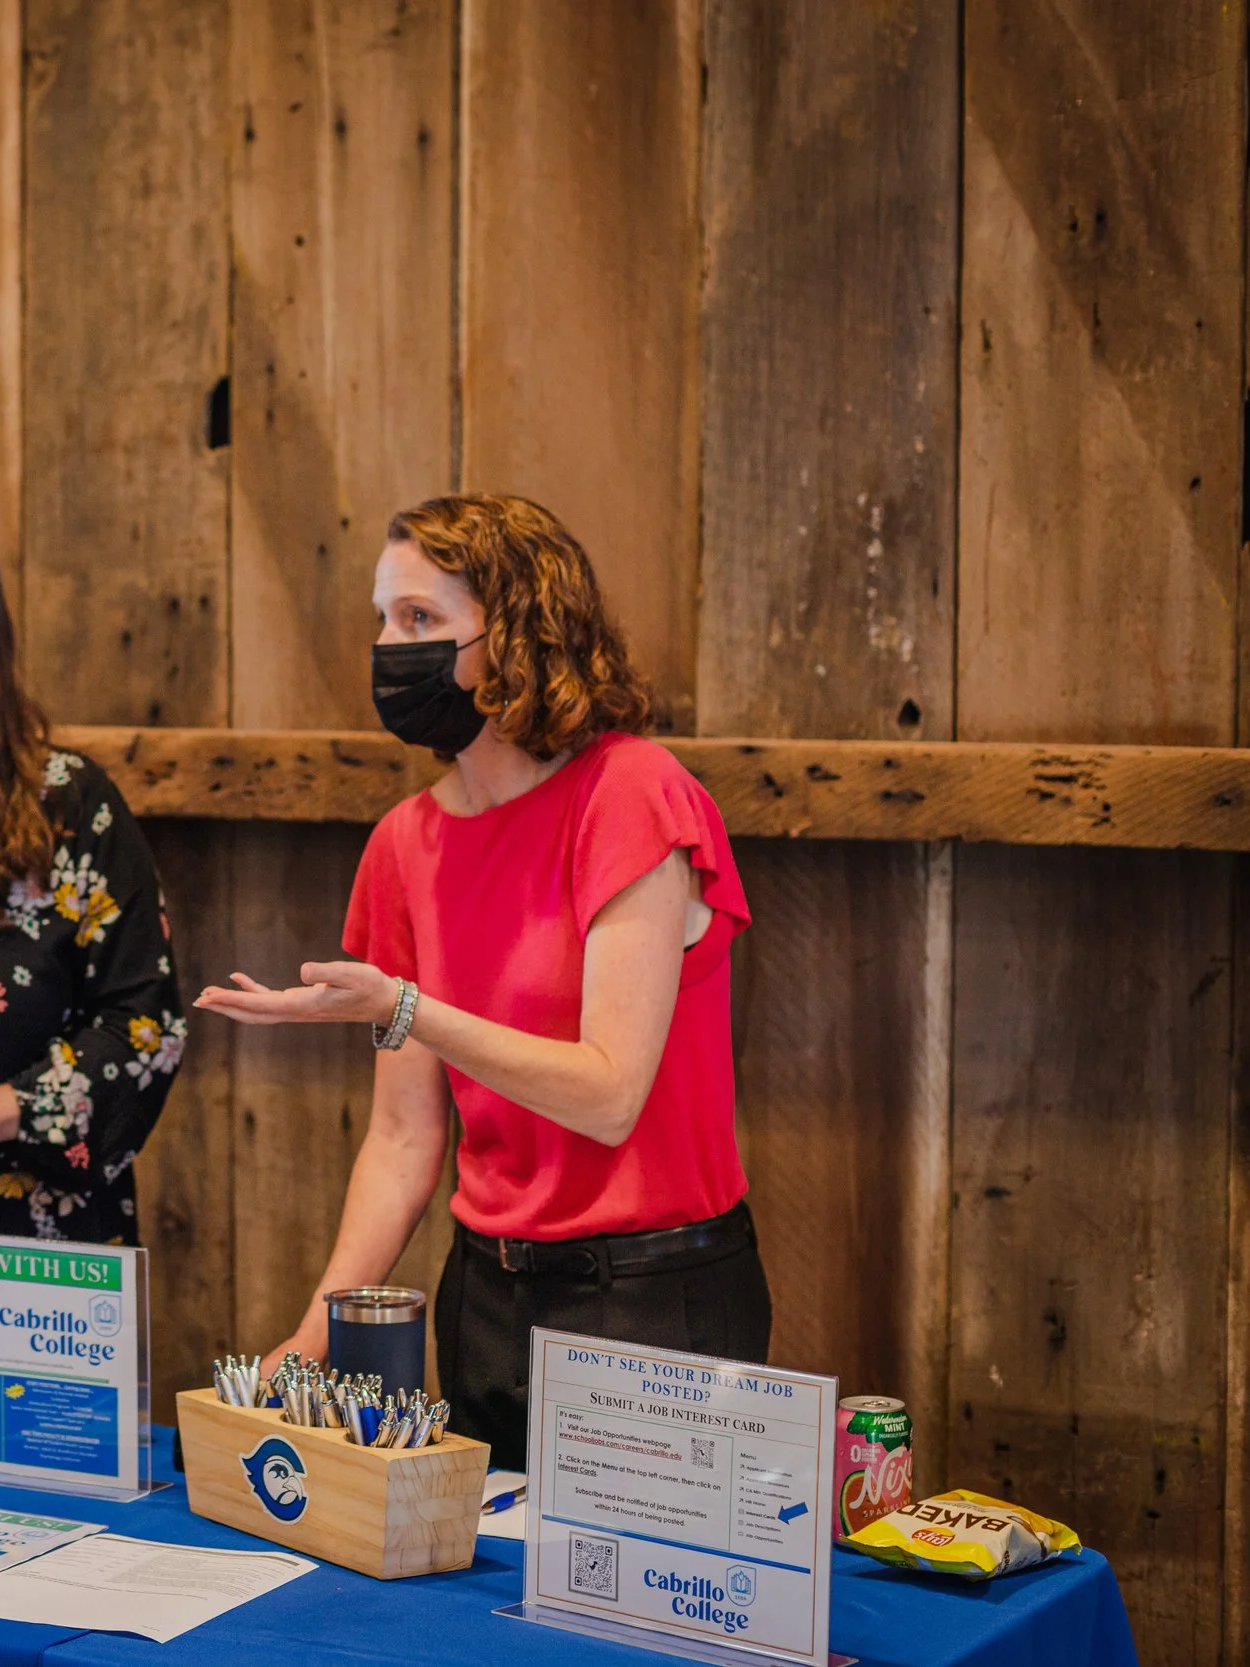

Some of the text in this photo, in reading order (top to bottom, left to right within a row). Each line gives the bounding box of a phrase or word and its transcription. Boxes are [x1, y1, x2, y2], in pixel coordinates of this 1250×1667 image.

[69, 1260, 109, 1284] US!
[30, 1333, 115, 1366] College
[567, 1349, 793, 1398] DON'T SEE YOUR DREAM JOB
[642, 1380, 710, 1402] POSTED?
[590, 1392, 766, 1434] SUBMIT A JOB INTEREST CARD
[603, 1430, 641, 1443] Opportunities
[642, 1438, 672, 1449] webpage
[884, 1423, 906, 1432] MINT
[740, 1452, 757, 1460] Menu
[850, 1445, 861, 1463] 0
[558, 1462, 579, 1473] Interest
[566, 1456, 580, 1464] Click
[602, 1462, 618, 1471] Menu
[637, 1469, 648, 1478] top
[659, 1474, 680, 1484] corner,
[682, 1478, 696, 1486] then
[696, 1481, 712, 1490] click
[575, 1487, 602, 1498] Subscribe
[626, 1498, 648, 1507] notified
[668, 1506, 707, 1518] opportunities
[620, 1508, 636, 1516] hours
[645, 1513, 662, 1522] being
[664, 1517, 685, 1526] posted.
[896, 1504, 1009, 1532] BAKED
[644, 1568, 724, 1602] Cabrillo
[672, 1597, 749, 1633] College
